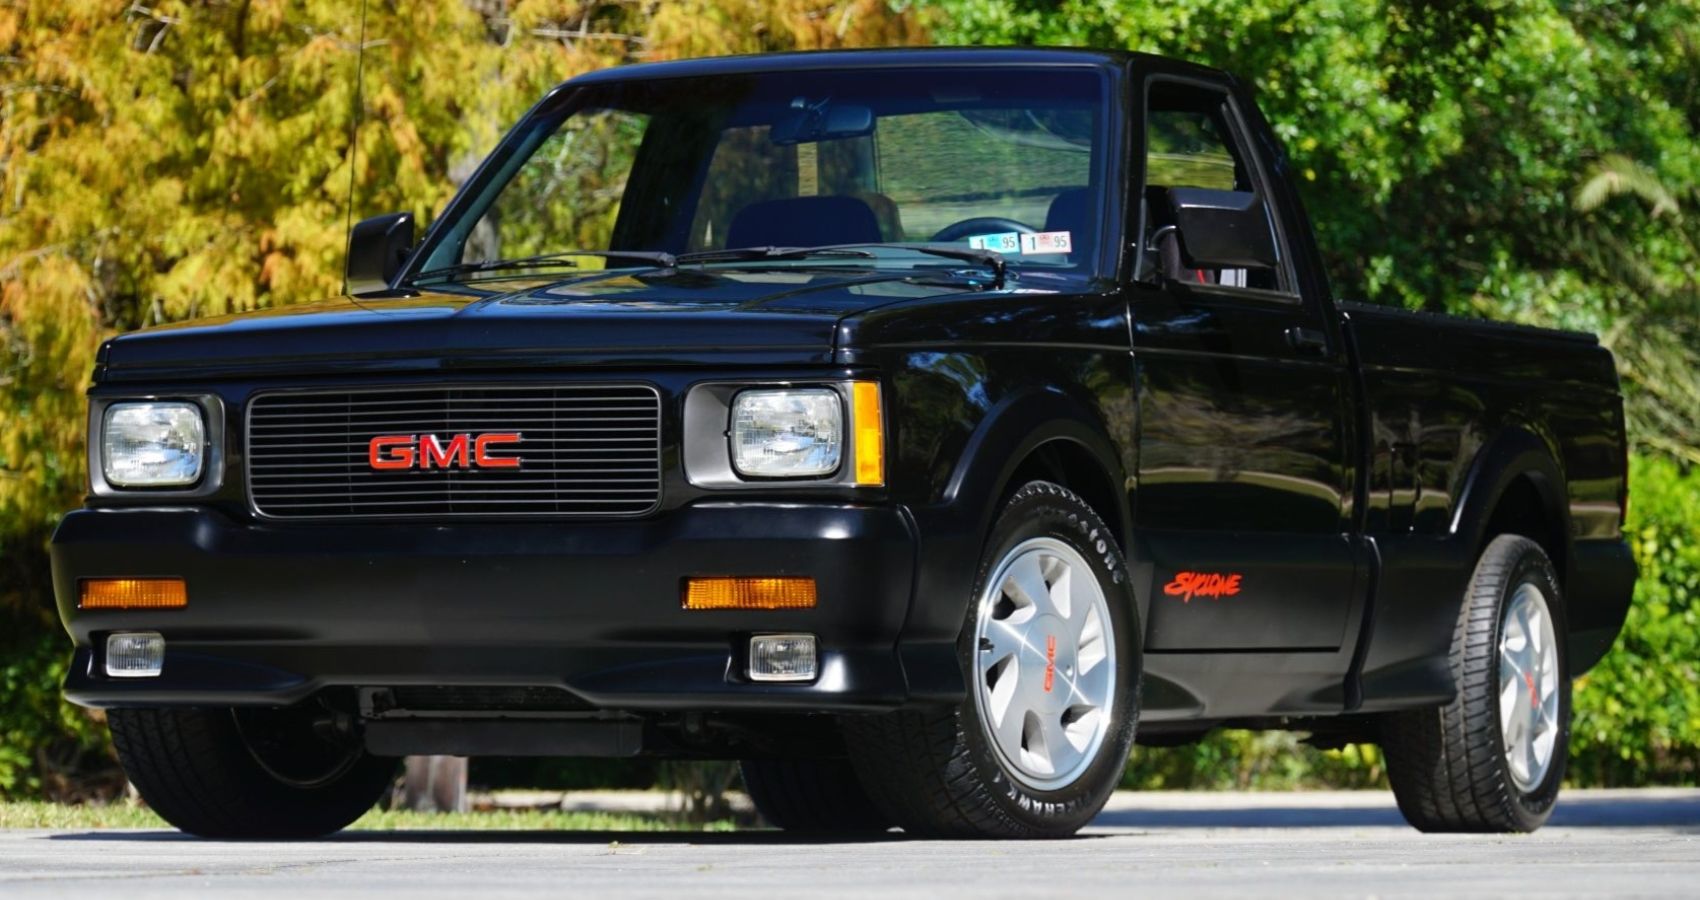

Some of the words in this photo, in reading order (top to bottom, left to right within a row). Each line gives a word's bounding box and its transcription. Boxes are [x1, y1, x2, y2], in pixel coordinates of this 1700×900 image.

[979, 238, 985, 250] 1
[1002, 236, 1016, 249] 95
[1030, 236, 1036, 250] 1
[1054, 235, 1067, 248] 95
[369, 432, 522, 470] GMC
[1036, 506, 1123, 584] estone
[1164, 572, 1242, 603] SYCLONE
[1043, 635, 1056, 693] GMC
